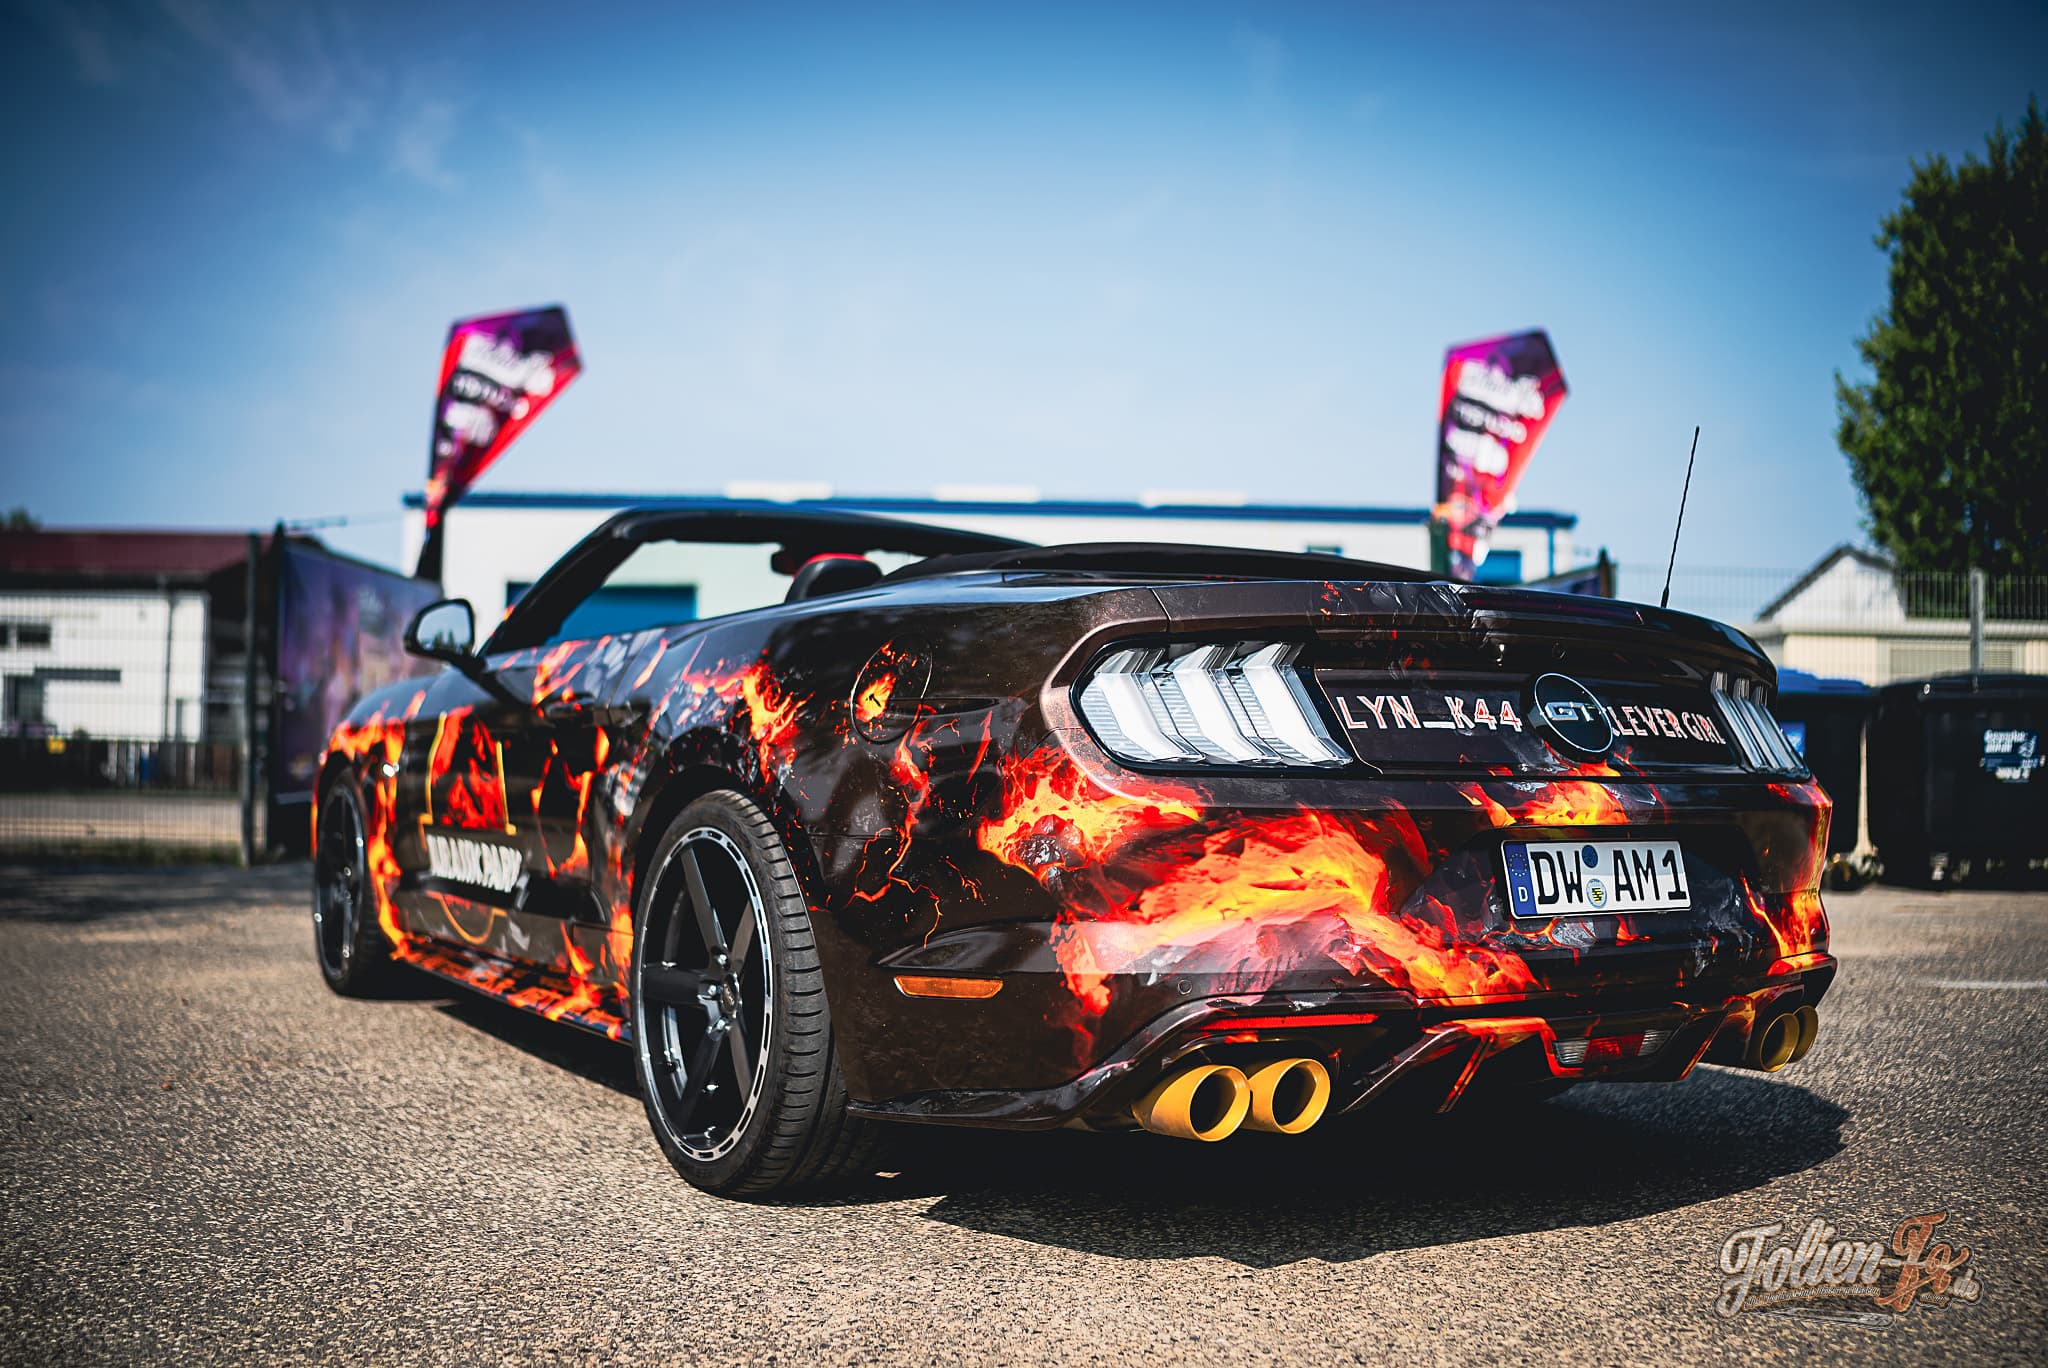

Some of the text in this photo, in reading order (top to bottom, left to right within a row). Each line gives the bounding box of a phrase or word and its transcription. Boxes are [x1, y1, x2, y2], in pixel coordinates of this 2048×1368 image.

[1544, 701, 1597, 722] GT
[1611, 705, 1726, 744] LEVER GIRL
[1530, 850, 1584, 905] DW
[1517, 886, 1529, 902] D
